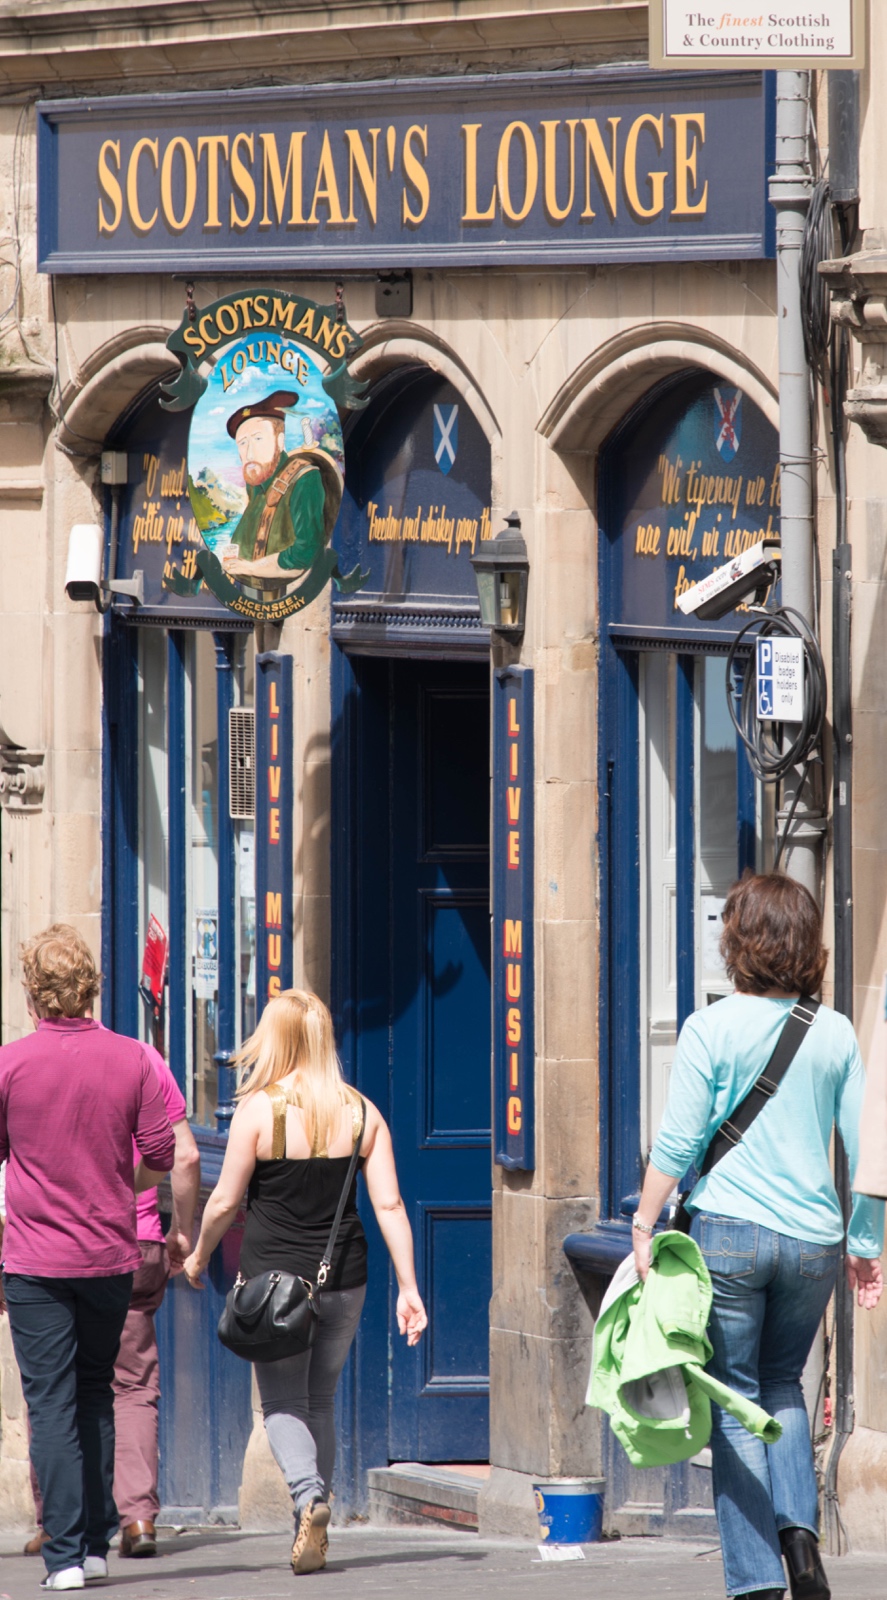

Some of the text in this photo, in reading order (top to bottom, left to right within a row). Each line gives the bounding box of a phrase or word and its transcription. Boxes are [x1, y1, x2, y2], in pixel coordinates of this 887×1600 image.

[682, 33, 835, 50] & Country Clothing
[685, 13, 831, 30] The finest Scottish
[97, 112, 709, 233] SCOTSMAN'S LOUNGE
[183, 295, 354, 359] SCOTSMAN'S
[220, 341, 310, 392] LOUNGE
[686, 460, 742, 519] tipenny
[746, 475, 766, 506] we
[132, 501, 165, 554] giftie
[165, 502, 184, 555] gie
[402, 505, 421, 541] and
[420, 505, 455, 554] whisky
[635, 524, 662, 556] nae
[229, 600, 256, 617] JOHN
[266, 596, 306, 620] MURPHY
[761, 643, 771, 674] P
[775, 651, 800, 664] Disabled
[778, 666, 796, 679] badge
[776, 679, 798, 690] holders
[266, 682, 282, 1001] LIVE MUS
[504, 698, 522, 1135] LIVE MUSIC
